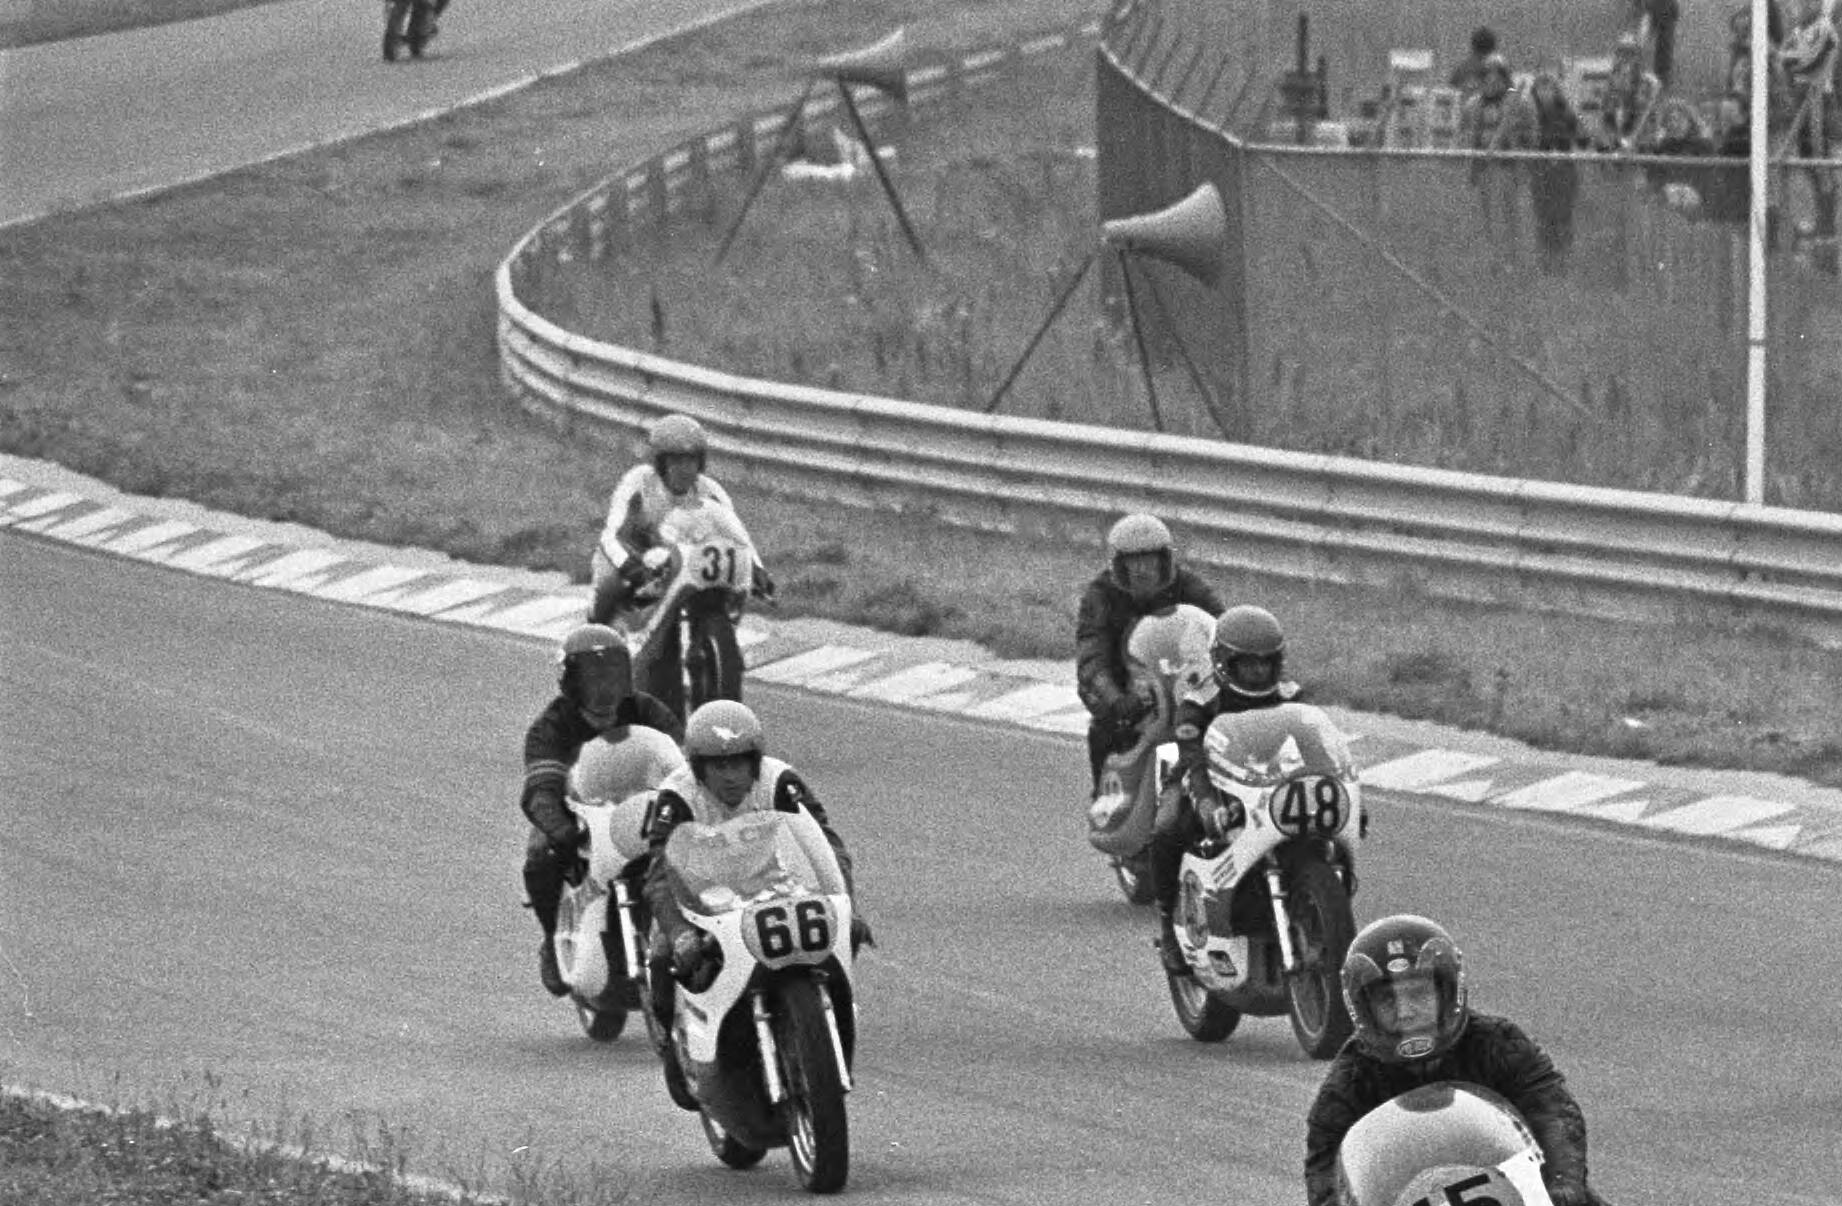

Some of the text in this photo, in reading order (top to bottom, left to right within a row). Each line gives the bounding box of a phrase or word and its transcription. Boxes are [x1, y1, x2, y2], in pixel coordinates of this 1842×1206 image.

[702, 545, 736, 583] 31
[1280, 777, 1340, 833] 48
[755, 900, 830, 959] 66
